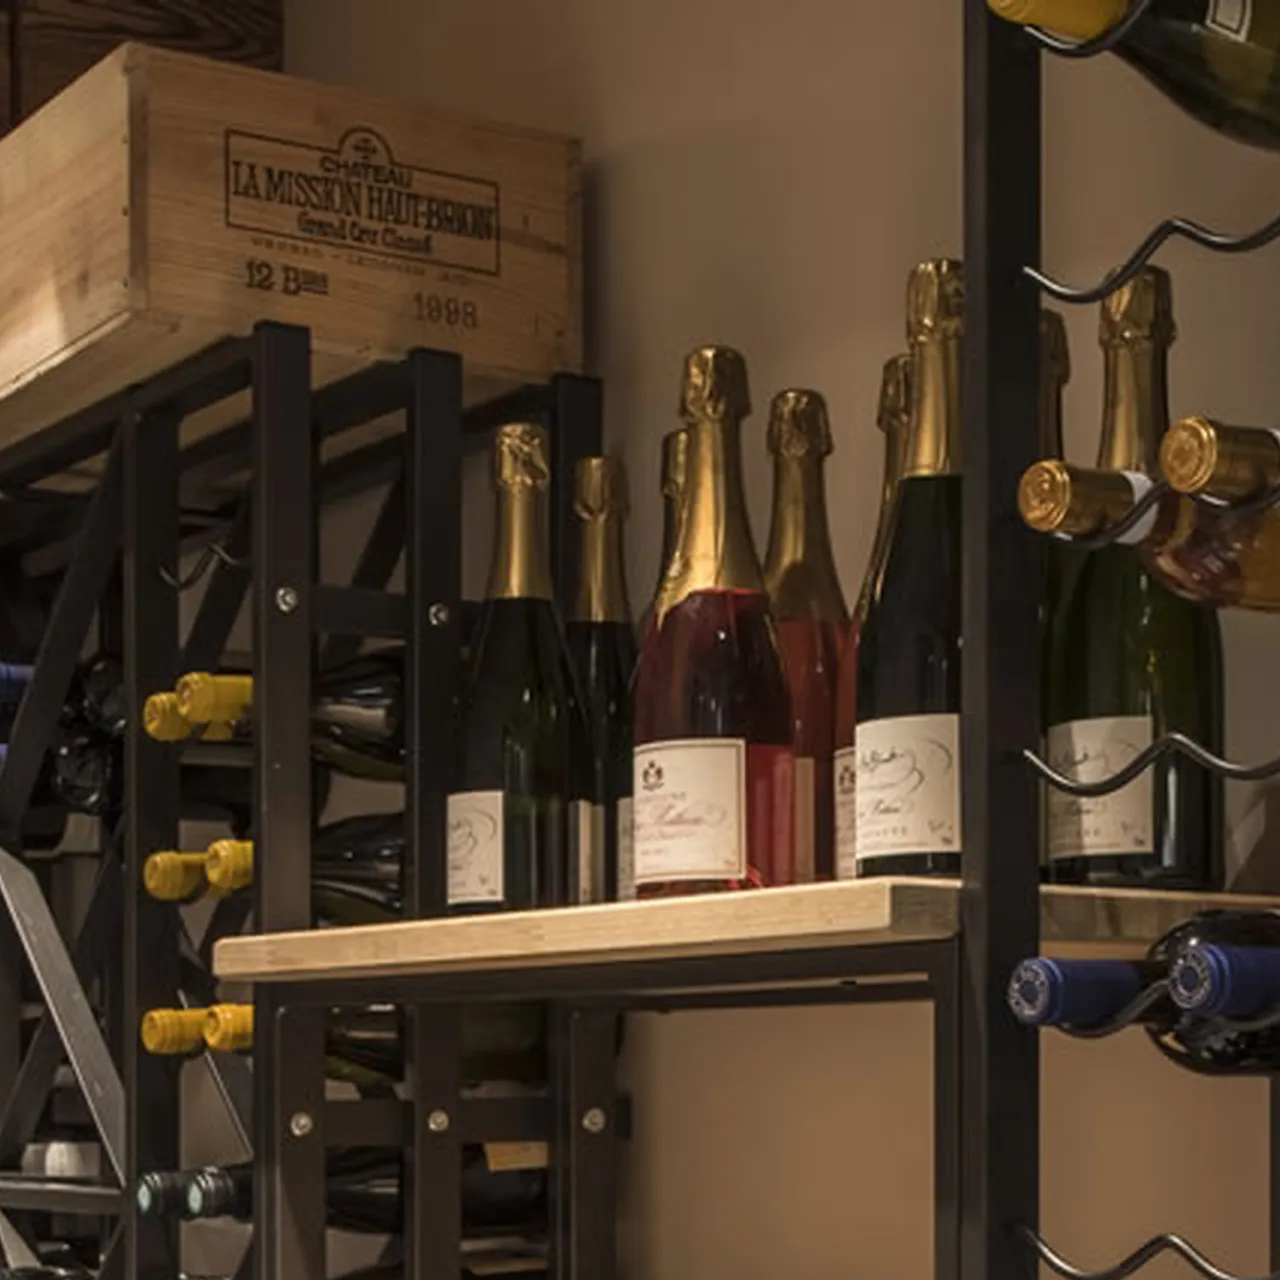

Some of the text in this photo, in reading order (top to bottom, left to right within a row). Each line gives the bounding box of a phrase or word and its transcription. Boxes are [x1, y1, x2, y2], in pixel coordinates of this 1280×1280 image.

[232, 160, 261, 198] LA
[262, 166, 360, 217] MISSION
[246, 260, 275, 291] 12
